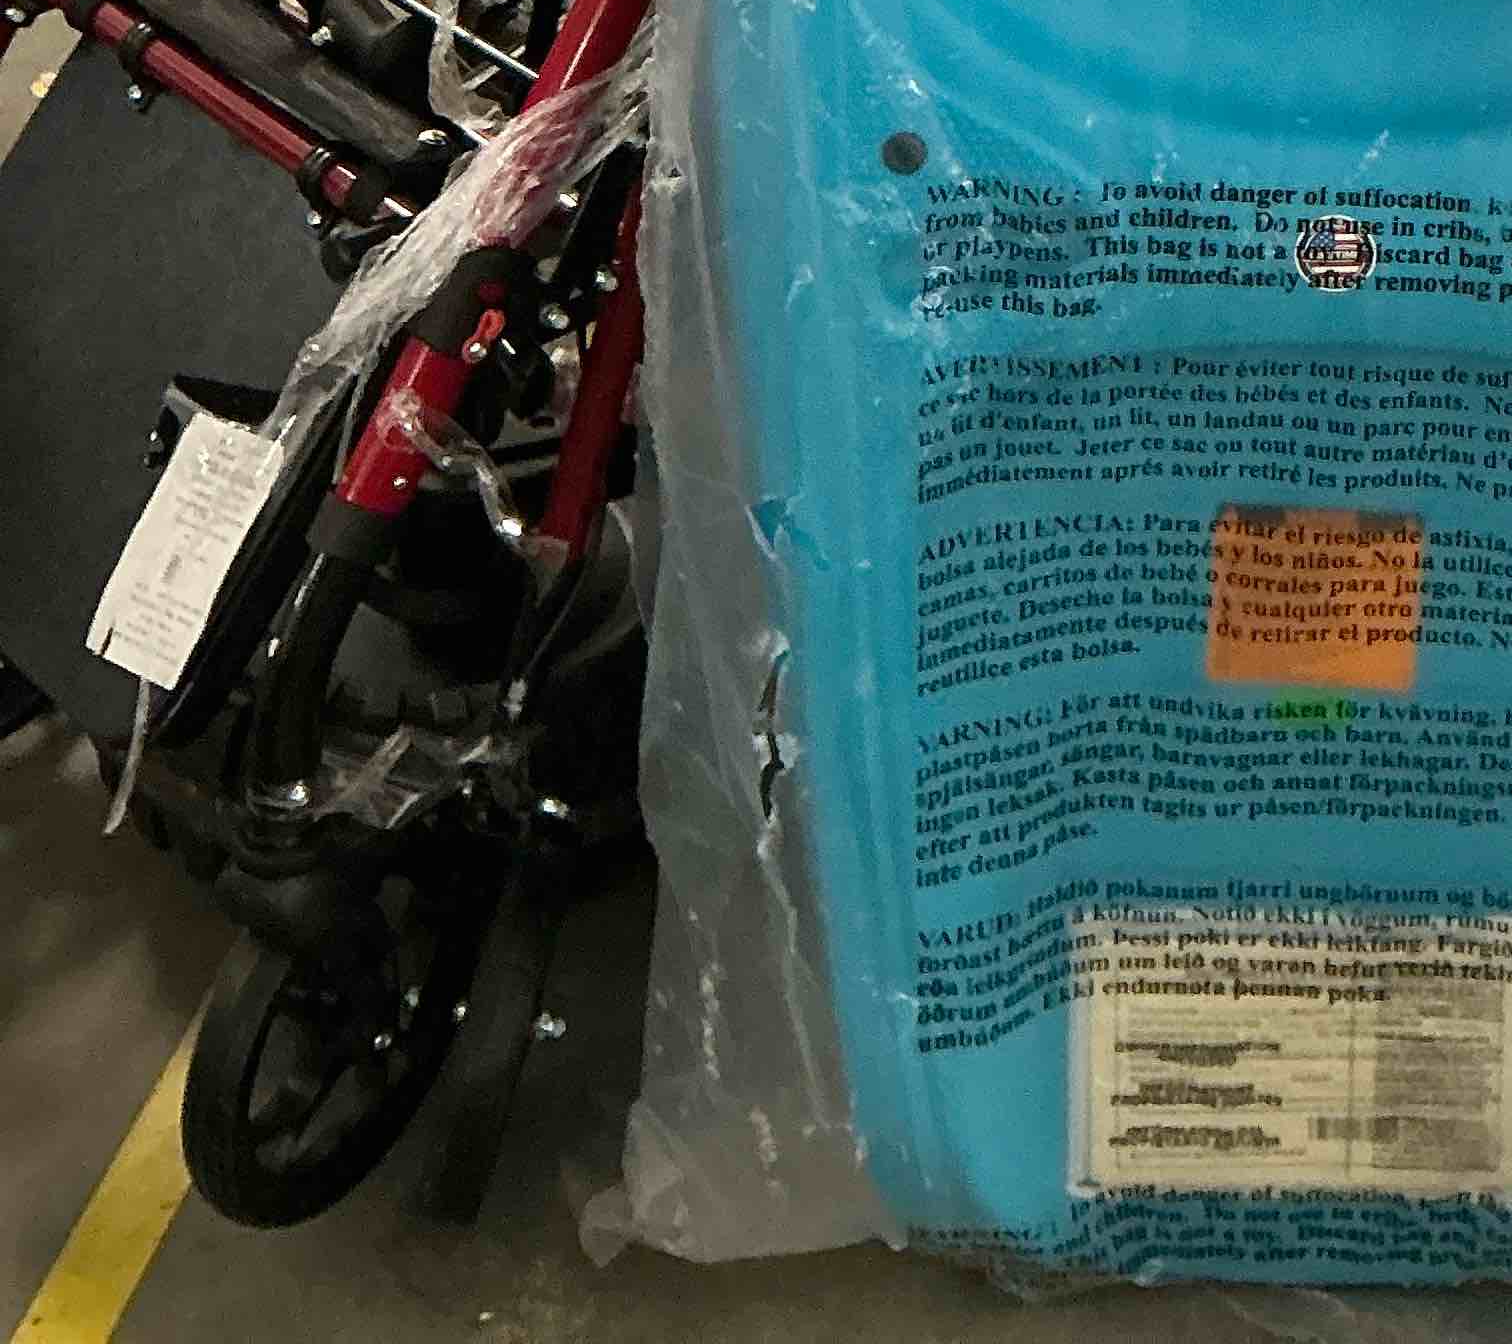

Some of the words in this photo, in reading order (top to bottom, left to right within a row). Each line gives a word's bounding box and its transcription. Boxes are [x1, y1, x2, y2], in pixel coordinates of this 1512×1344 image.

[1210, 185, 1297, 208] danger
[1129, 207, 1237, 232] children.
[1375, 276, 1491, 301] removing
[1173, 357, 1231, 378] Pour
[1329, 577, 1386, 599] para
[1366, 626, 1482, 648] producto.
[1072, 768, 1140, 788] Kasta
